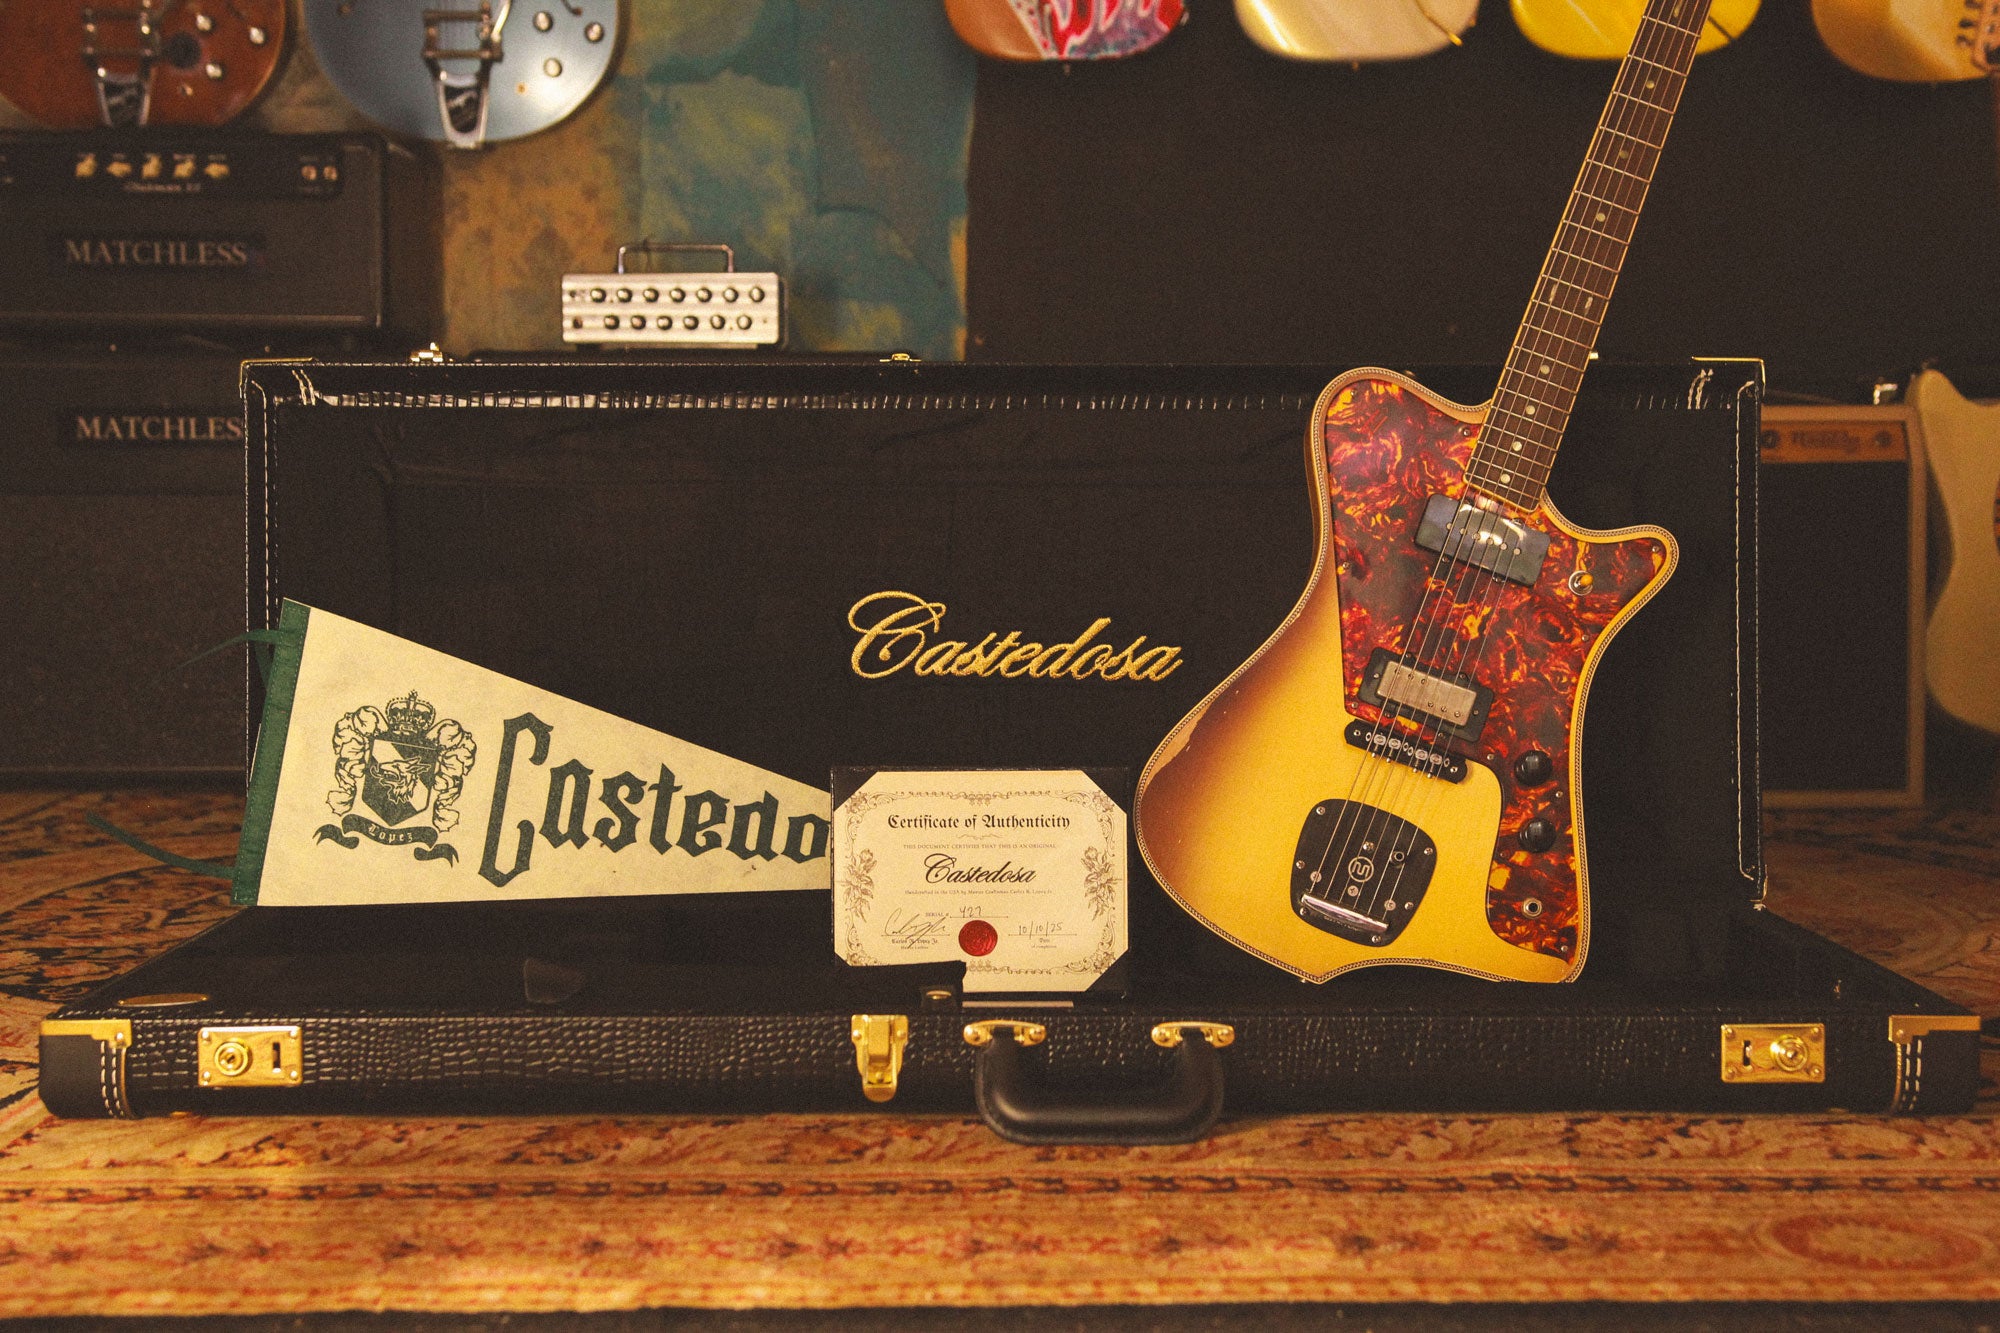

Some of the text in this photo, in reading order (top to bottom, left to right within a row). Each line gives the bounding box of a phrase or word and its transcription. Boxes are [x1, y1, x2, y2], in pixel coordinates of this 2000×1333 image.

[66, 239, 247, 265] MATCHLESS
[77, 416, 242, 441] MATCHLES
[848, 590, 1183, 682] Castedosa
[478, 711, 831, 888] Castedo
[368, 823, 413, 843] Lopez
[887, 813, 1071, 831] Certificate of Authenticity
[923, 852, 1037, 884] Castedosa
